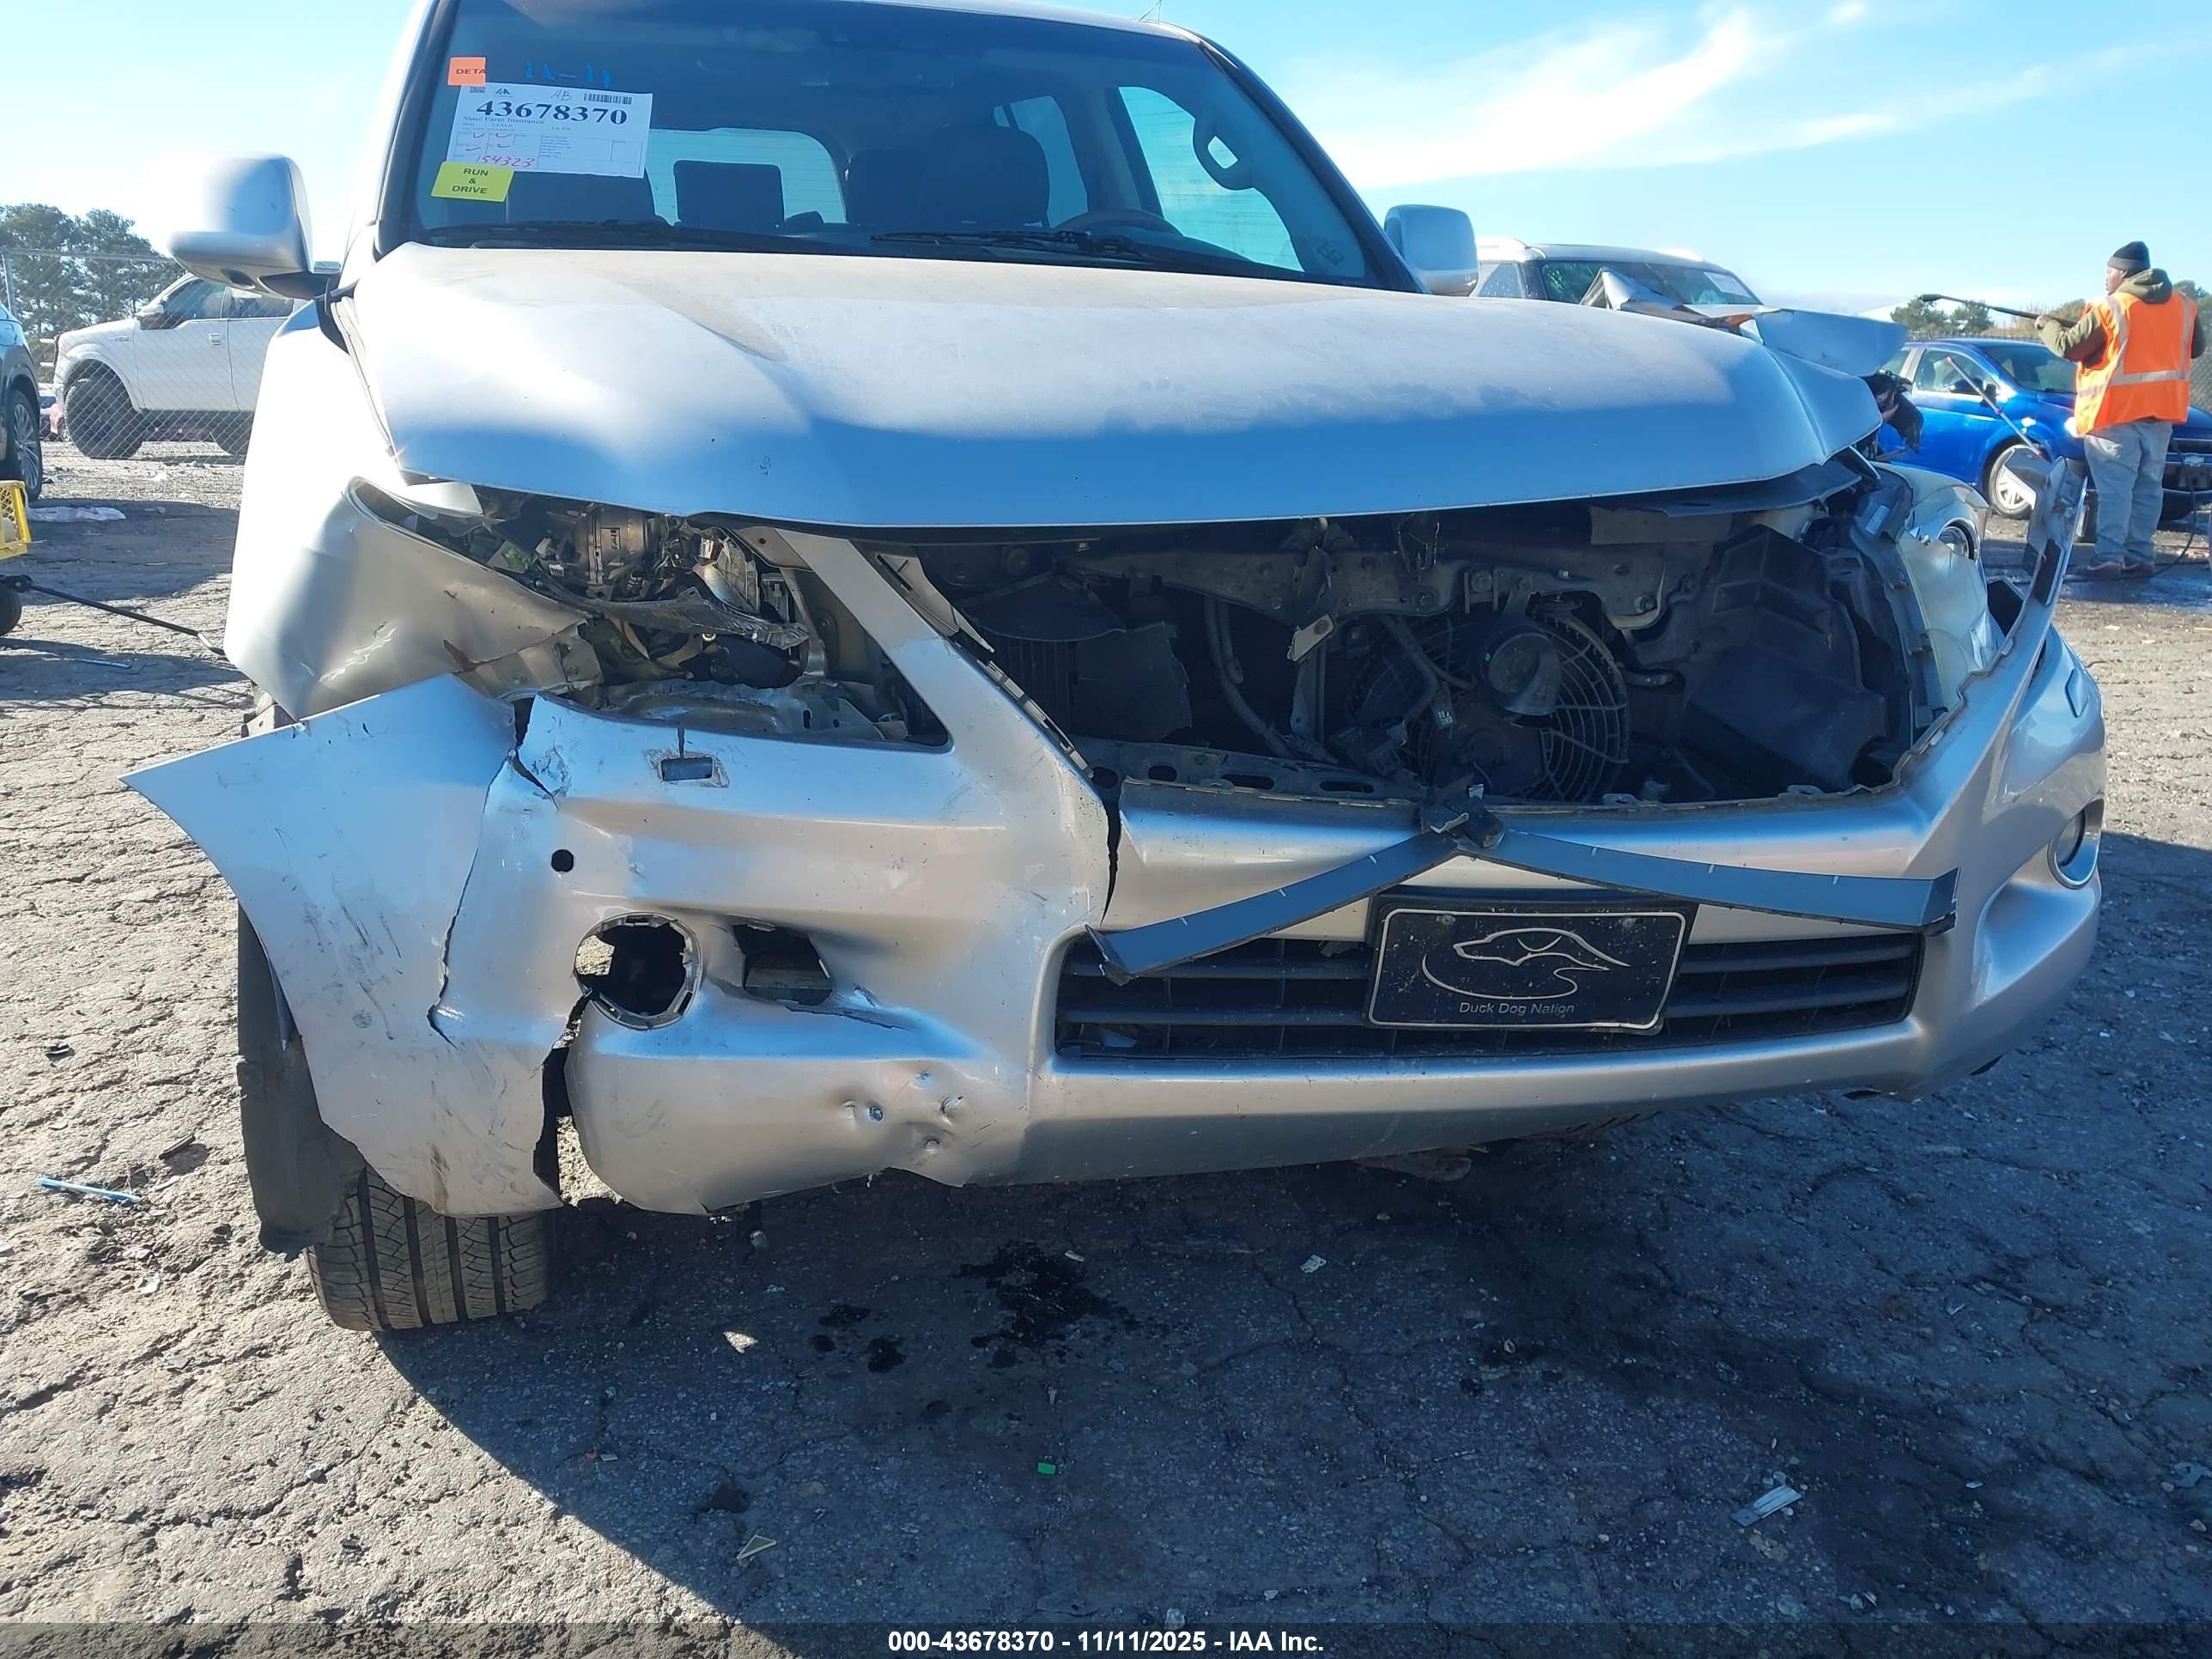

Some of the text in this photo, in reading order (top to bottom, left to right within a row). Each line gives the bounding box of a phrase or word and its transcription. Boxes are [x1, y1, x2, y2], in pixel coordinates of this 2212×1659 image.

[477, 100, 627, 125] 43678370
[463, 167, 489, 176] RUN
[452, 185, 488, 194] DRIVE
[1459, 1002, 1575, 1016] Duck Dog Nation
